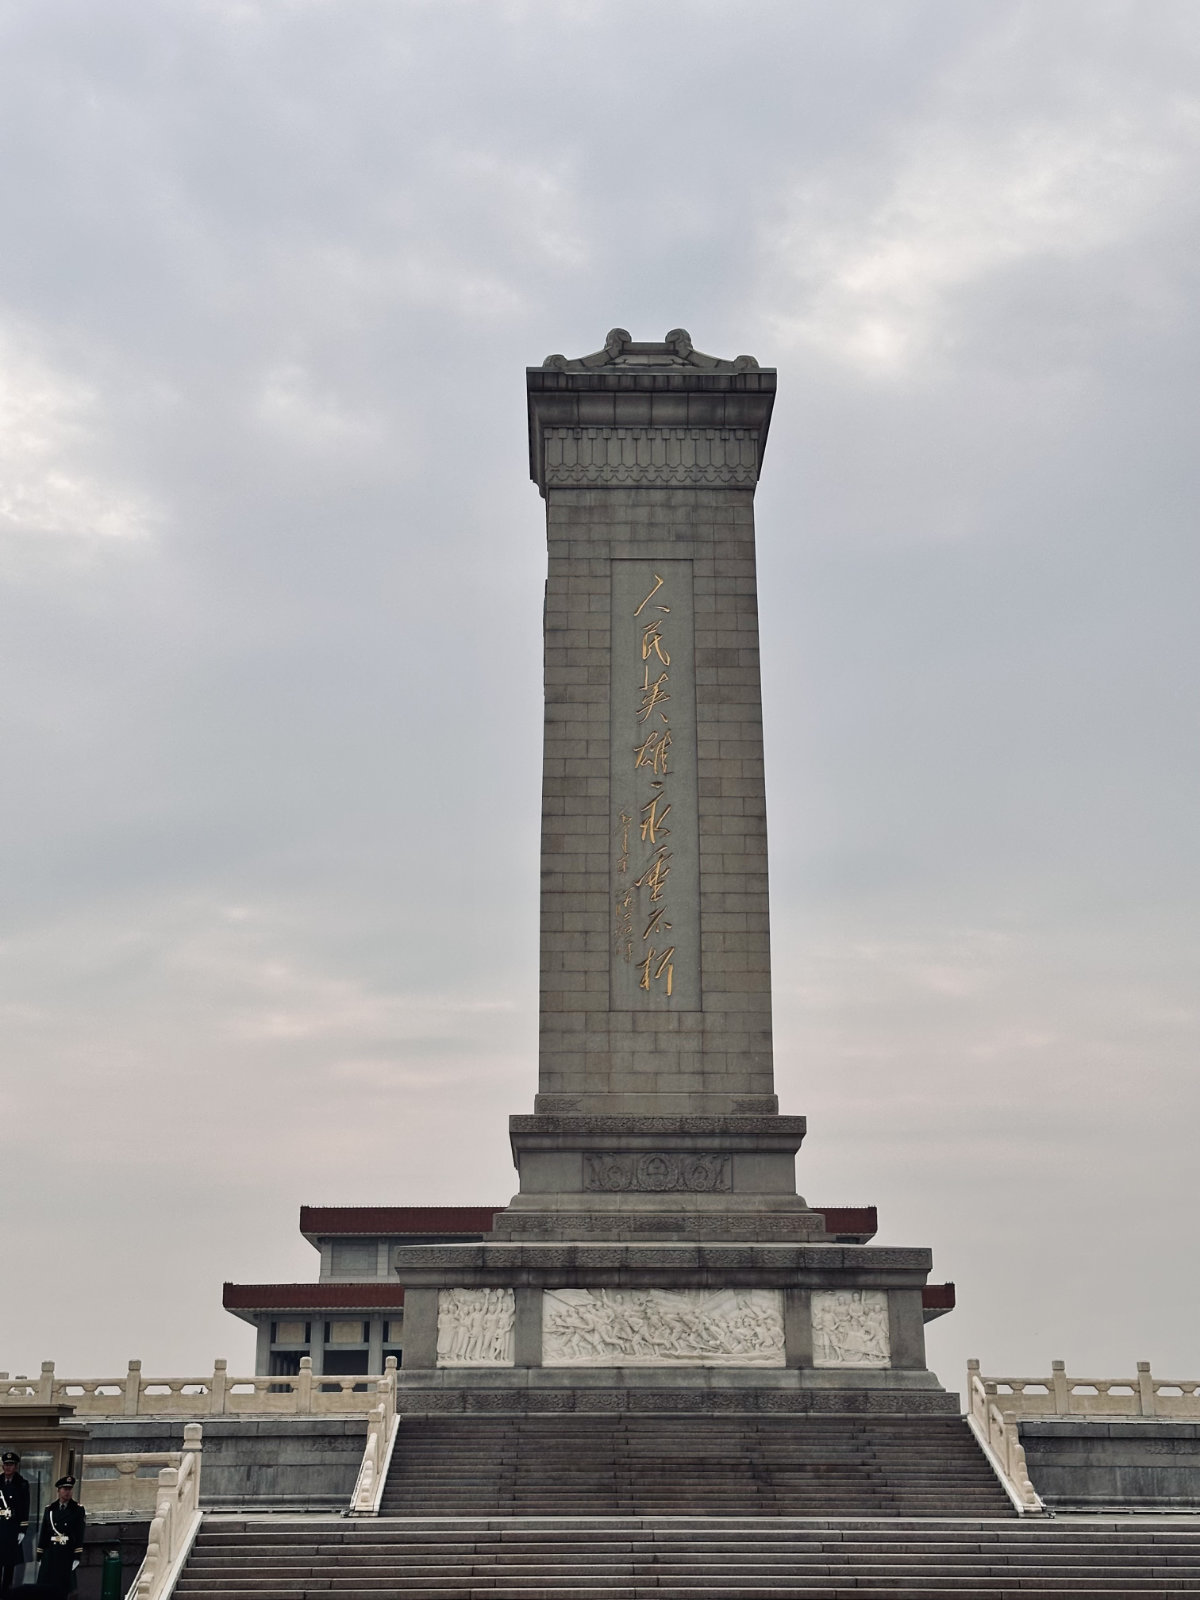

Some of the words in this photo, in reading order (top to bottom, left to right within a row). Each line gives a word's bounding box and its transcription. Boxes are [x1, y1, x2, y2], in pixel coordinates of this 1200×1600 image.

[633, 573, 675, 997] 人民英雄永垂不朽
